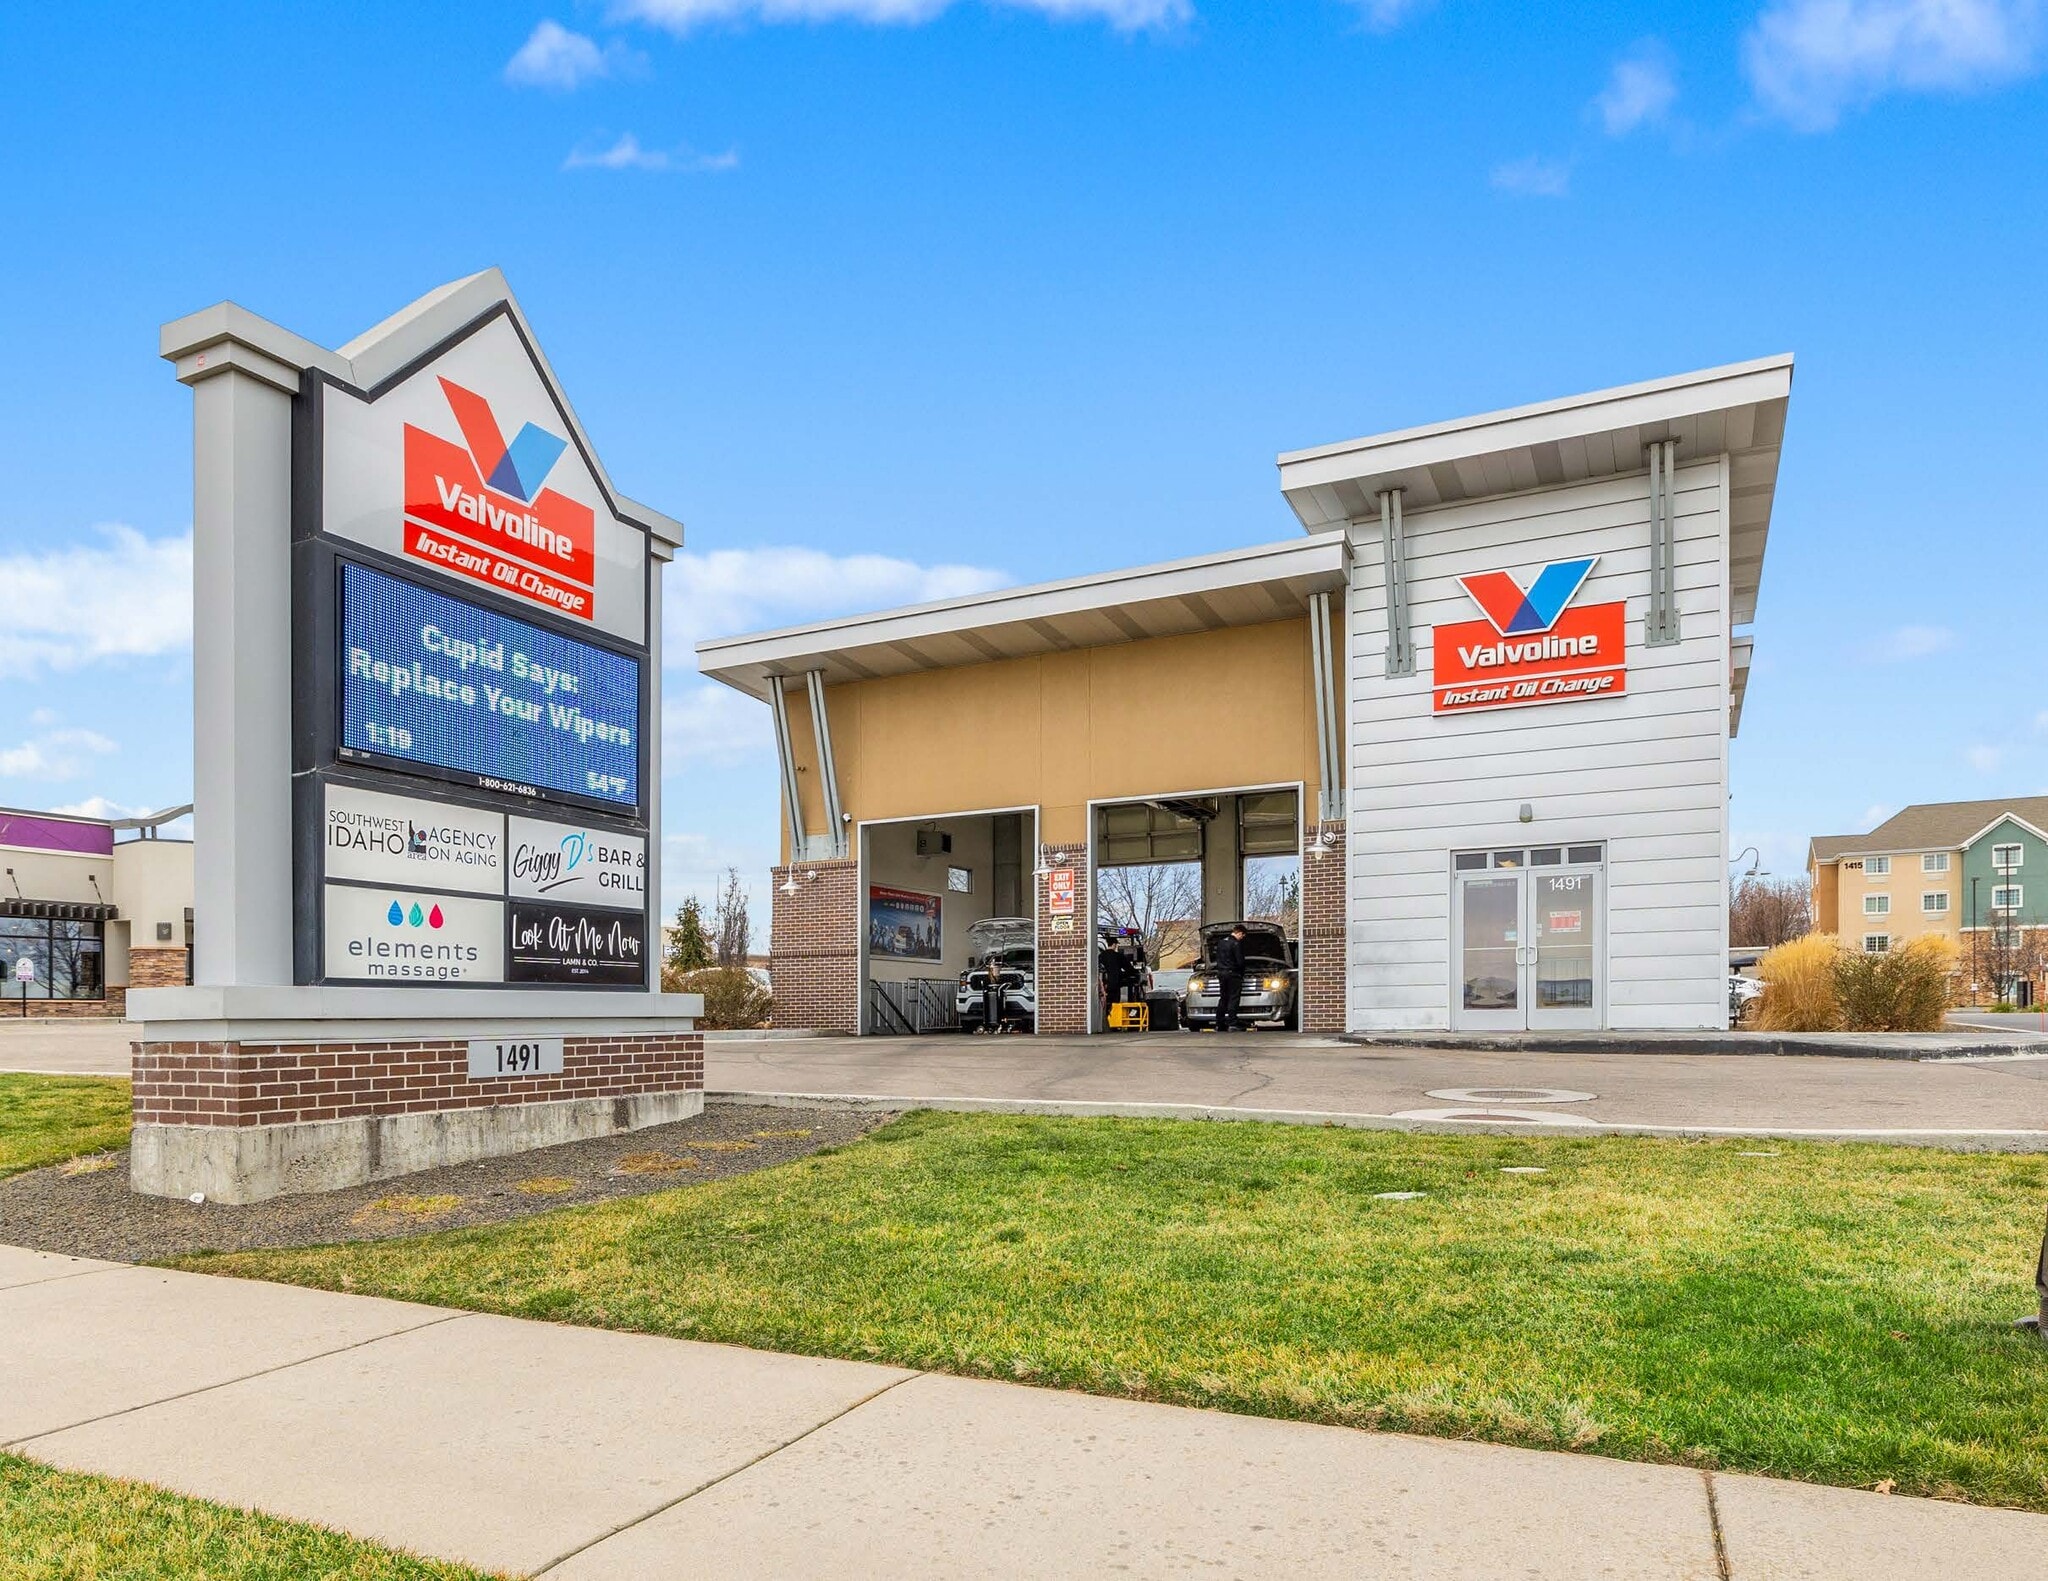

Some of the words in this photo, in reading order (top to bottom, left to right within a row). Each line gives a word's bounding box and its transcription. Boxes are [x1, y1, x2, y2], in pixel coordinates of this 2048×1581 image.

[434, 473, 574, 561] Valvoline
[416, 532, 491, 575] Instant
[492, 561, 520, 586] Oil
[520, 572, 585, 611] Change
[423, 624, 503, 671] Cupid
[512, 651, 579, 695] Says:
[1457, 634, 1598, 669] Valvoline
[351, 647, 475, 705] Replace
[484, 684, 541, 722] Your
[549, 702, 630, 745] Wipers
[1442, 684, 1510, 706] Instant
[1512, 680, 1539, 697] Oil
[1540, 675, 1614, 695] Change
[478, 776, 537, 797] 1-800-621-6836
[329, 810, 405, 833] SOUTHWEST
[328, 825, 405, 855] IDAHO
[429, 827, 497, 850] AGENCY
[429, 846, 450, 861] ON
[455, 851, 497, 867] AGING
[513, 844, 561, 883] Giggy
[560, 831, 594, 870] D's
[598, 846, 632, 867] BAR
[636, 852, 645, 868] &
[598, 871, 644, 892] GRILL
[1053, 872, 1070, 882] EXIT
[1053, 881, 1071, 891] ONLY
[1550, 876, 1581, 891] 1491
[512, 914, 543, 950] Look
[548, 916, 575, 952] At
[575, 917, 604, 956] Me
[607, 920, 641, 958] Now
[348, 937, 478, 961] elements
[368, 963, 460, 980] massage
[496, 1044, 539, 1072] 1491
